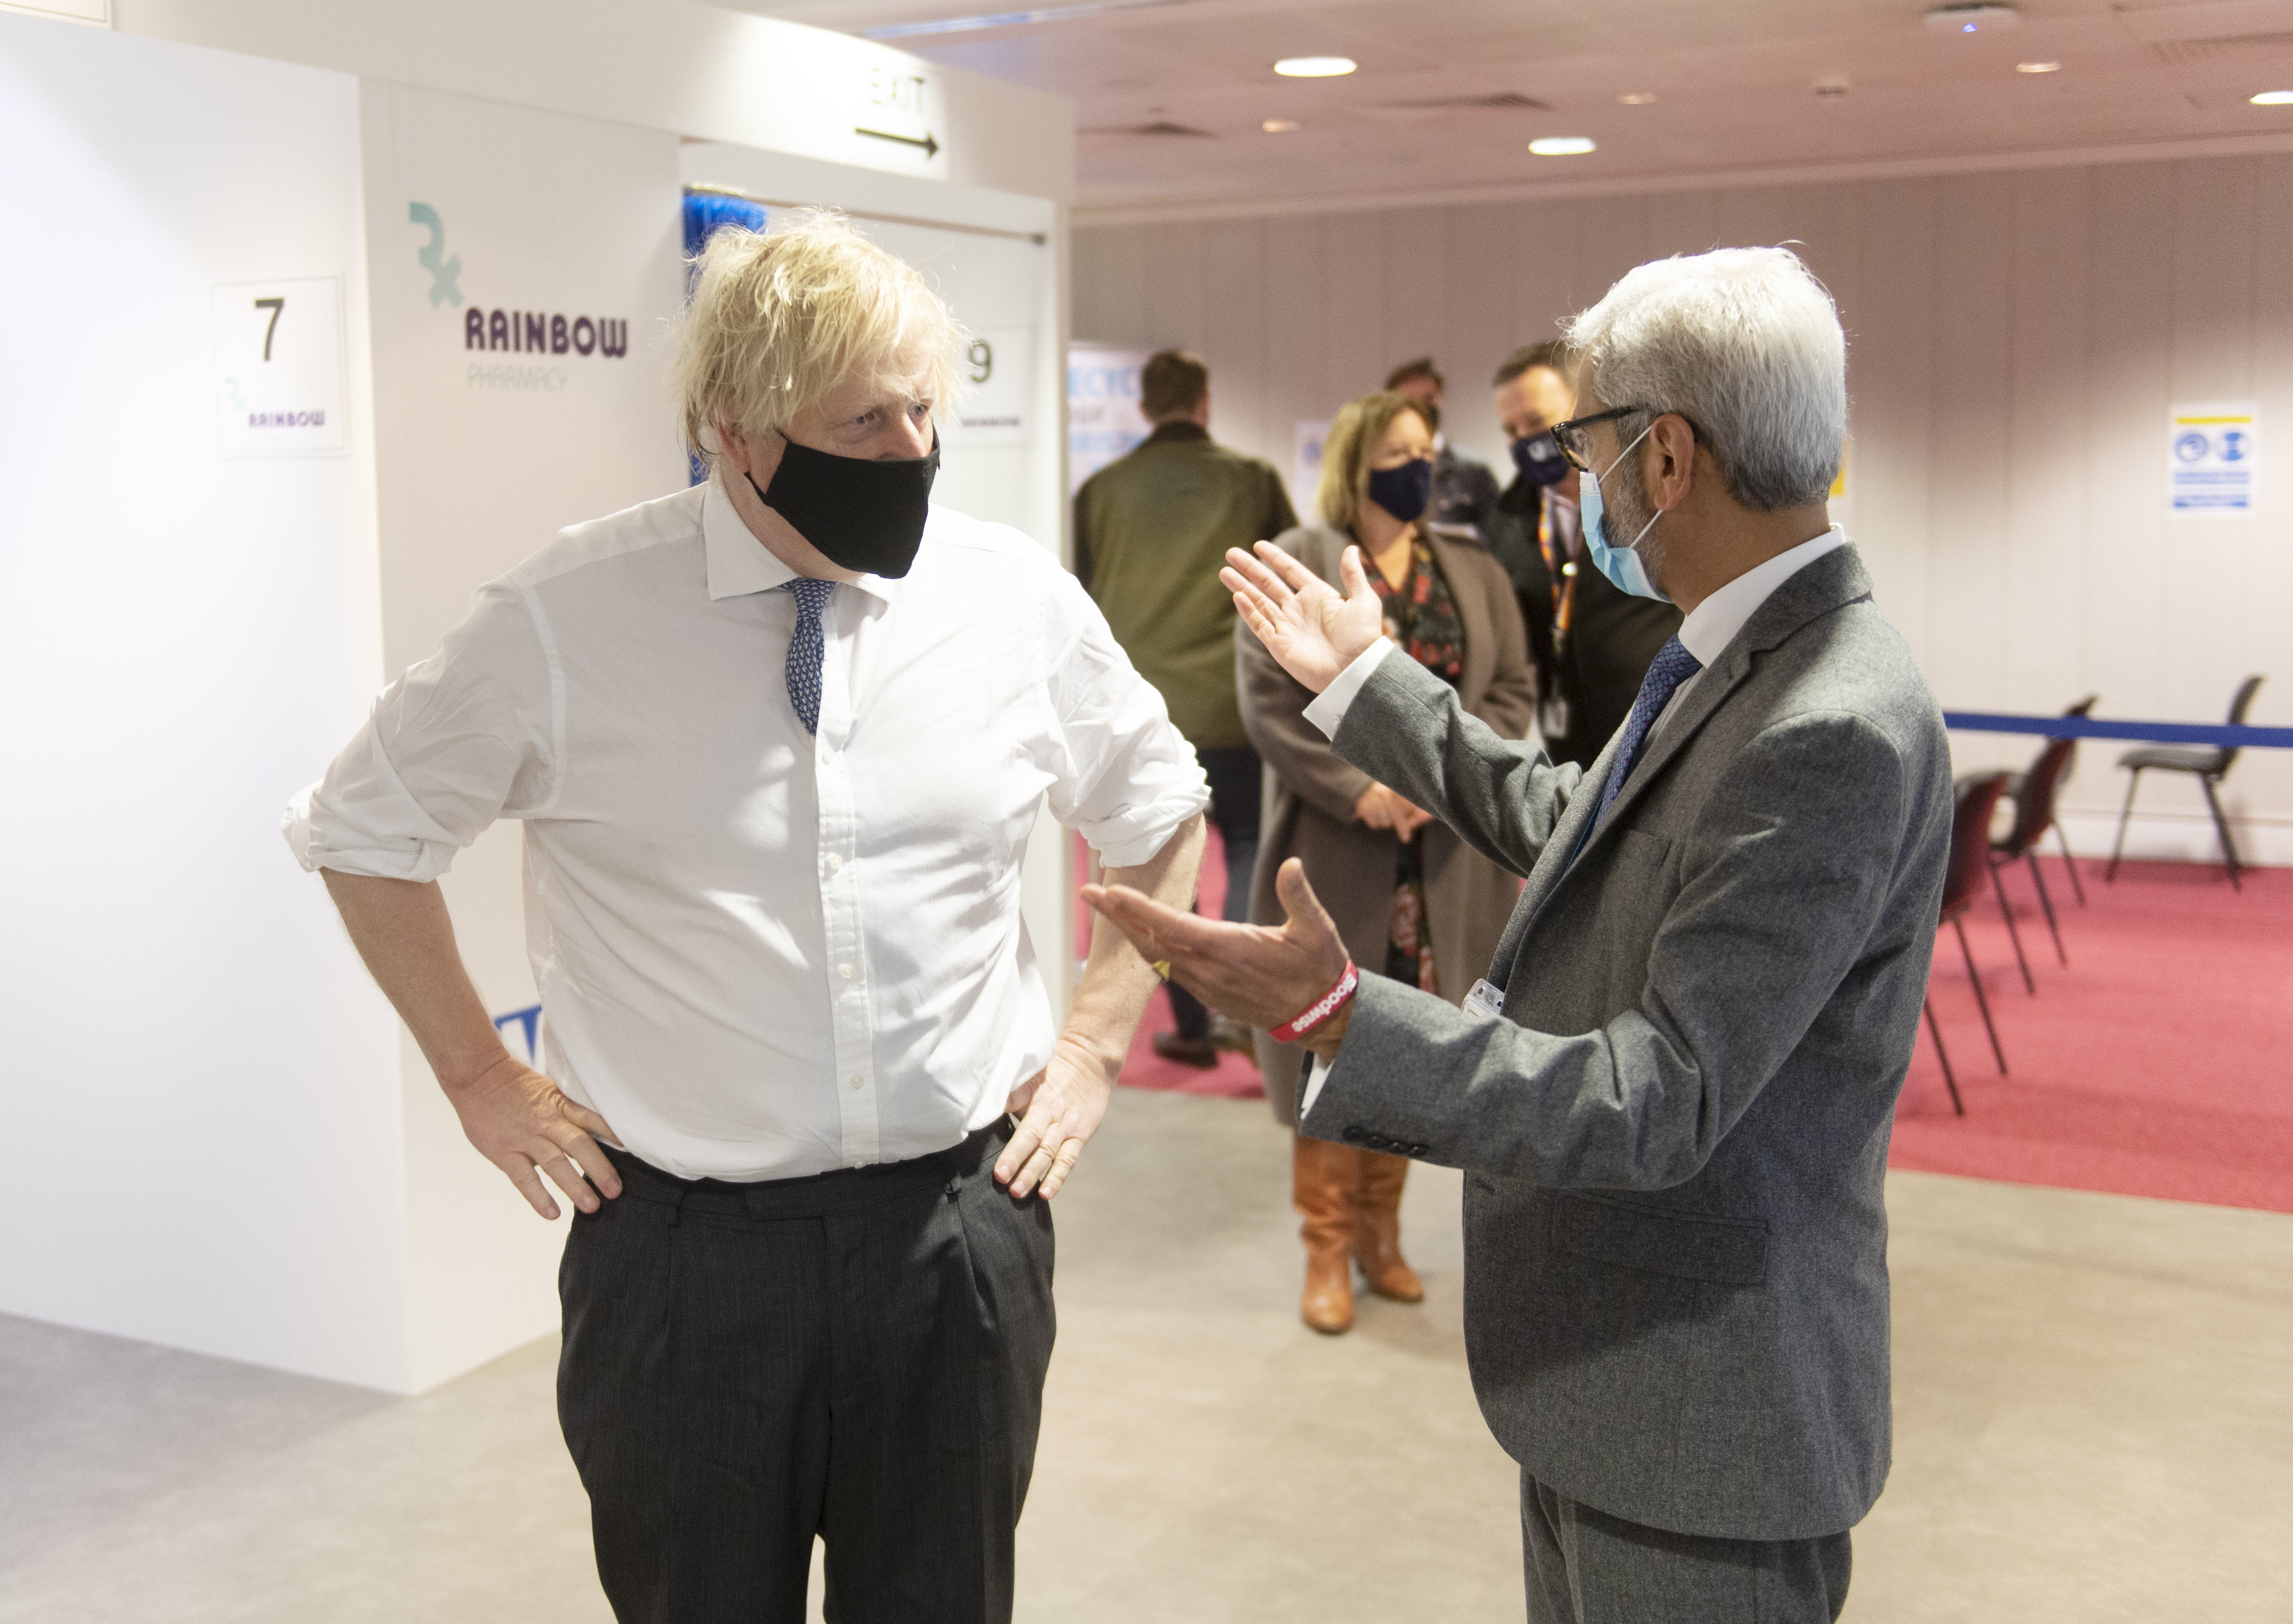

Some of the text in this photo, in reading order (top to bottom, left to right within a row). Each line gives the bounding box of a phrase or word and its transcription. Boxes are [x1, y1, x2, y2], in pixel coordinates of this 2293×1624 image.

[255, 297, 285, 362] 7
[465, 307, 627, 358] RAINBOW
[467, 364, 568, 392] PHARMACY
[968, 340, 993, 383] 9
[248, 410, 326, 428] RAINBOW
